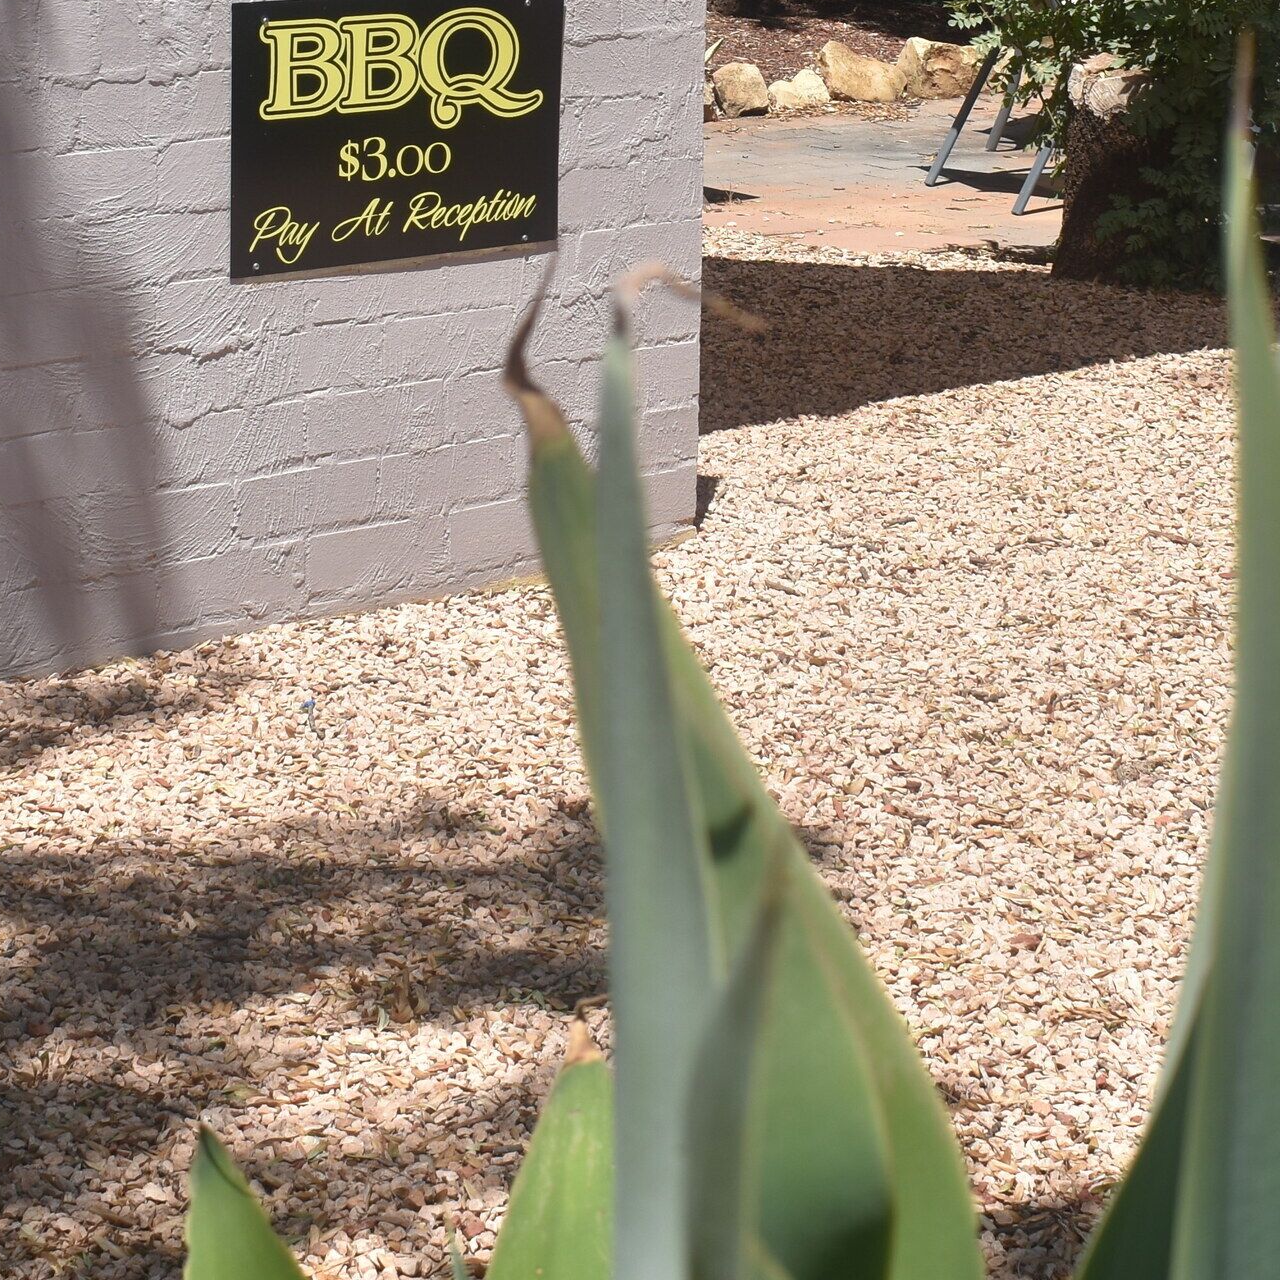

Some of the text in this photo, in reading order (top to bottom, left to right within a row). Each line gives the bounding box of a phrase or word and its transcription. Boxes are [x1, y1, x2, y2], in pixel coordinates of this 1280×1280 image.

[259, 7, 543, 129] BBQ
[338, 136, 451, 182] $3.00
[249, 189, 537, 264] Pay At Reception
